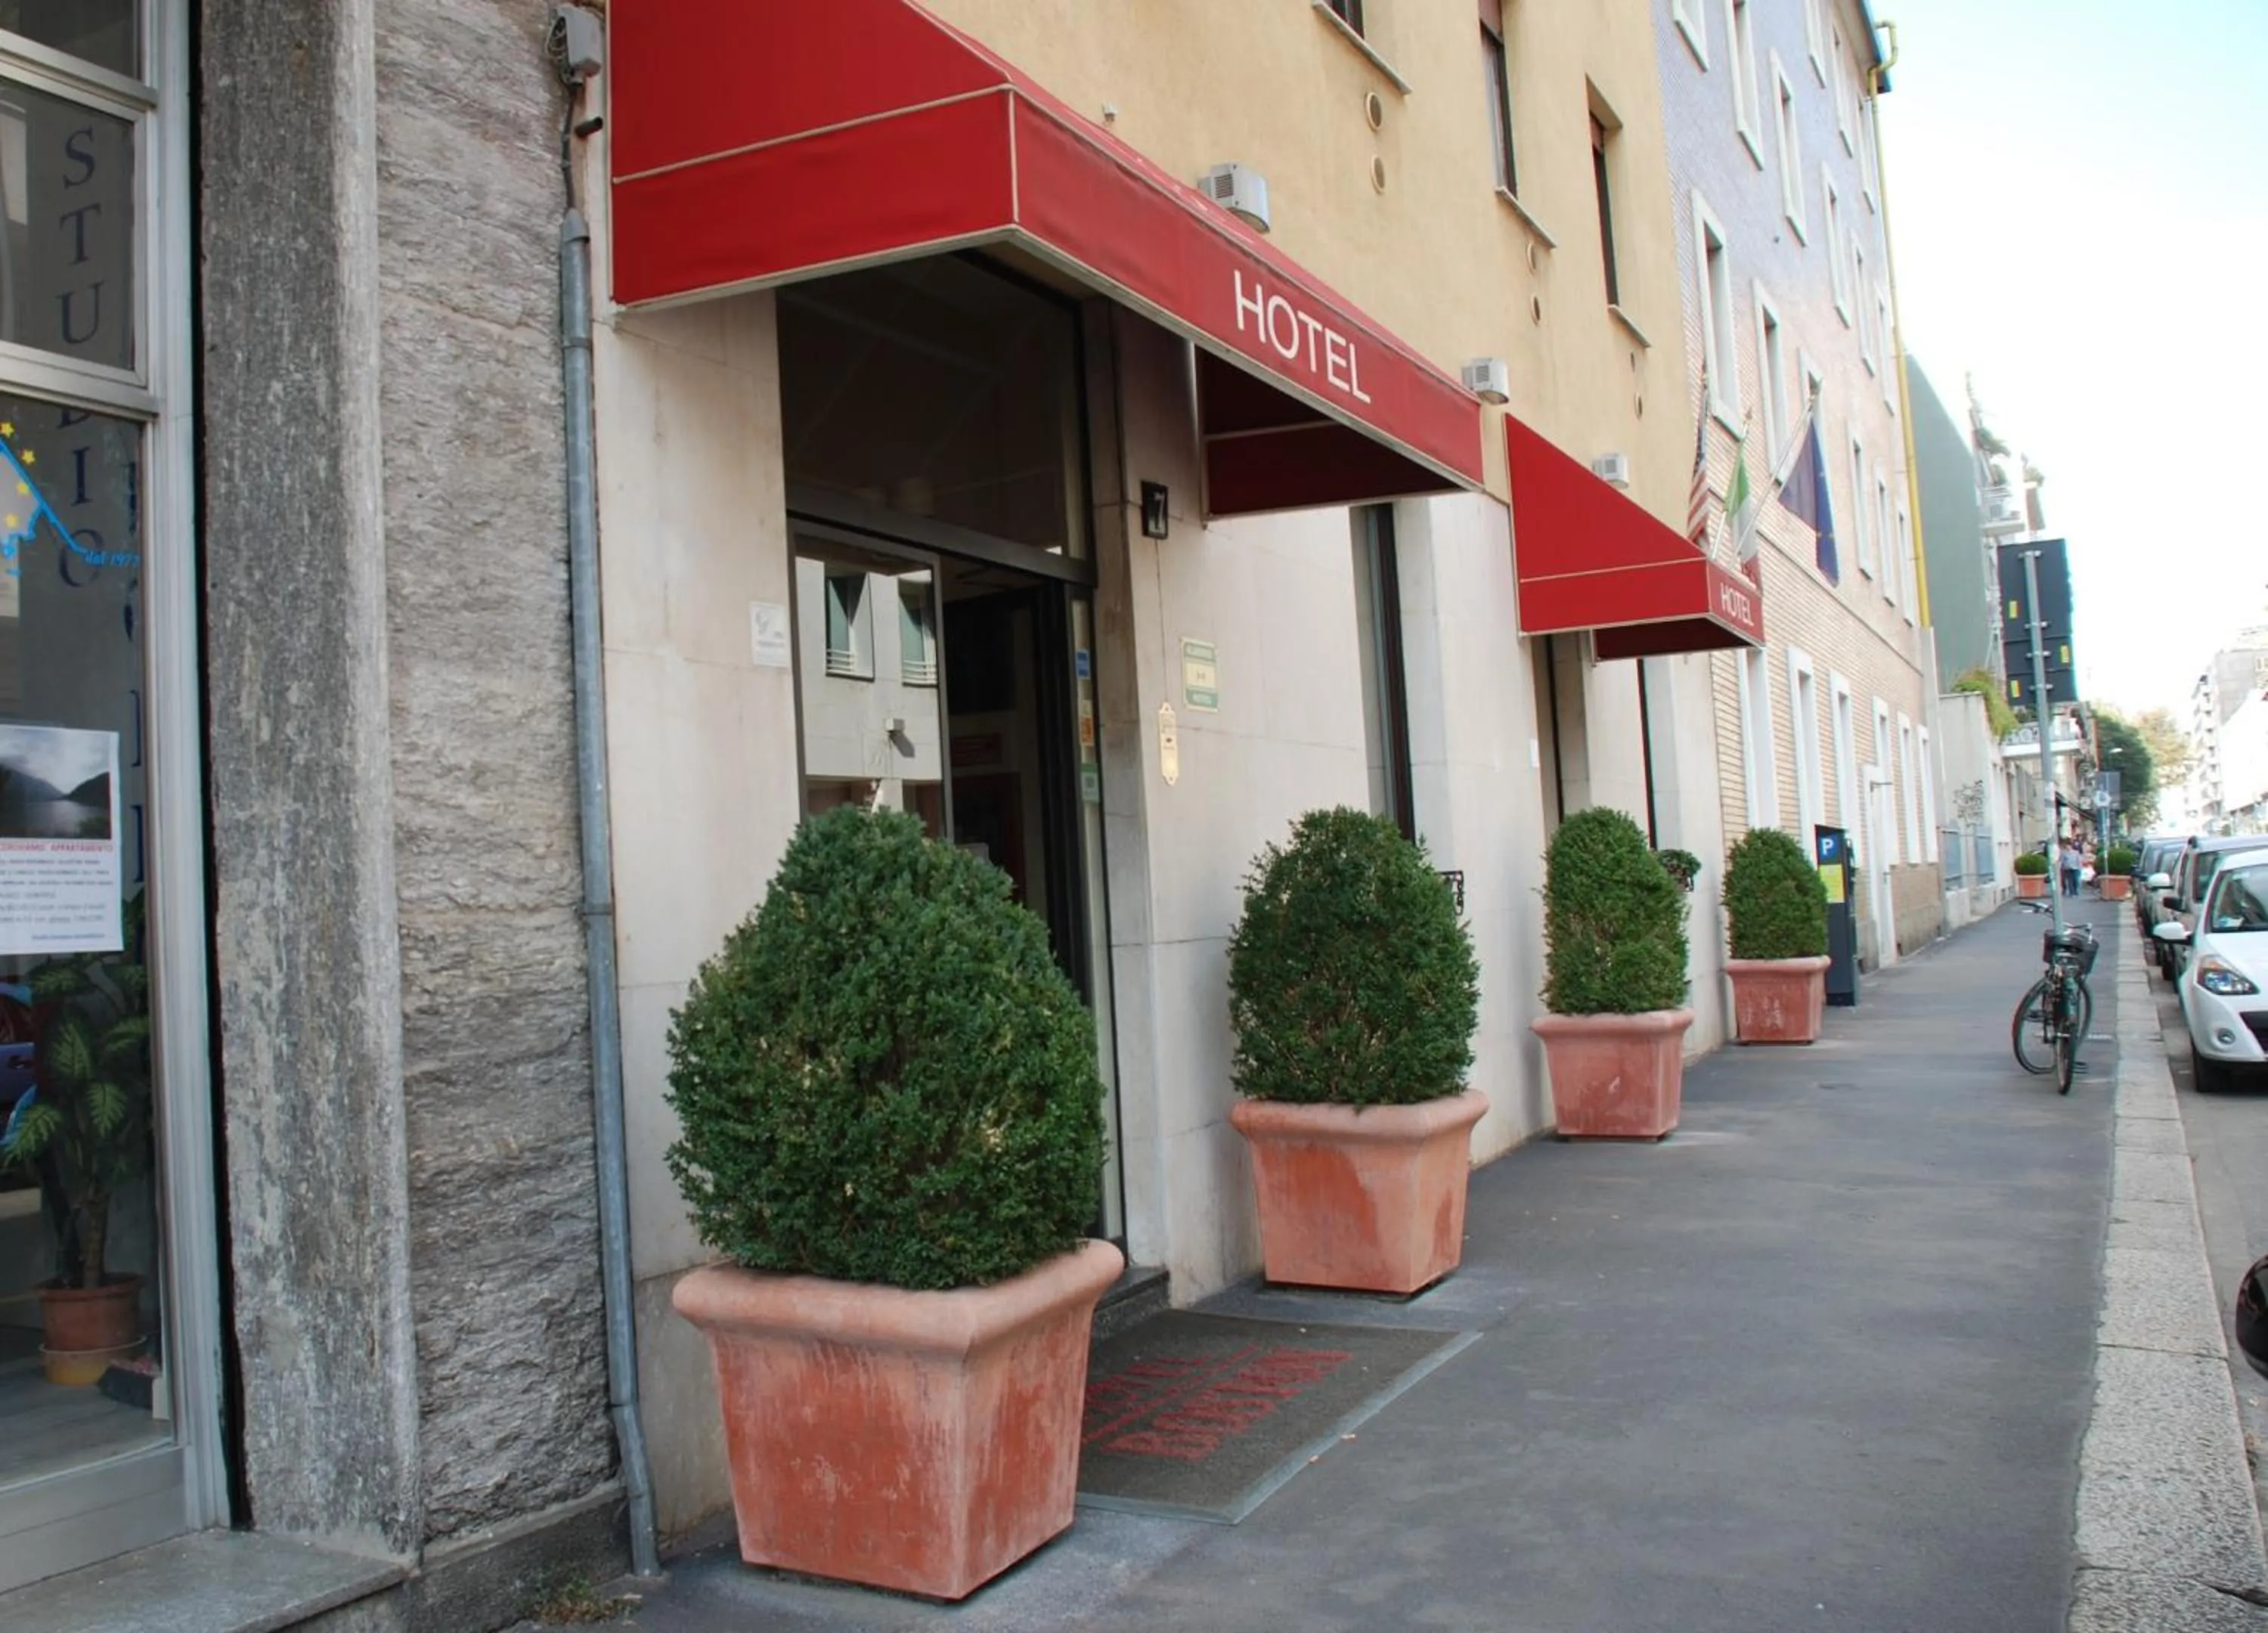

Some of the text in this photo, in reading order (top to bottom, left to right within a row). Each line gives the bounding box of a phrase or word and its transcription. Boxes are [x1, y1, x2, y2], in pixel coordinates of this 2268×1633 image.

[1234, 268, 1371, 404] HOTEL
[1720, 581, 1754, 626] HOTEL
[1821, 837, 1834, 855] P
